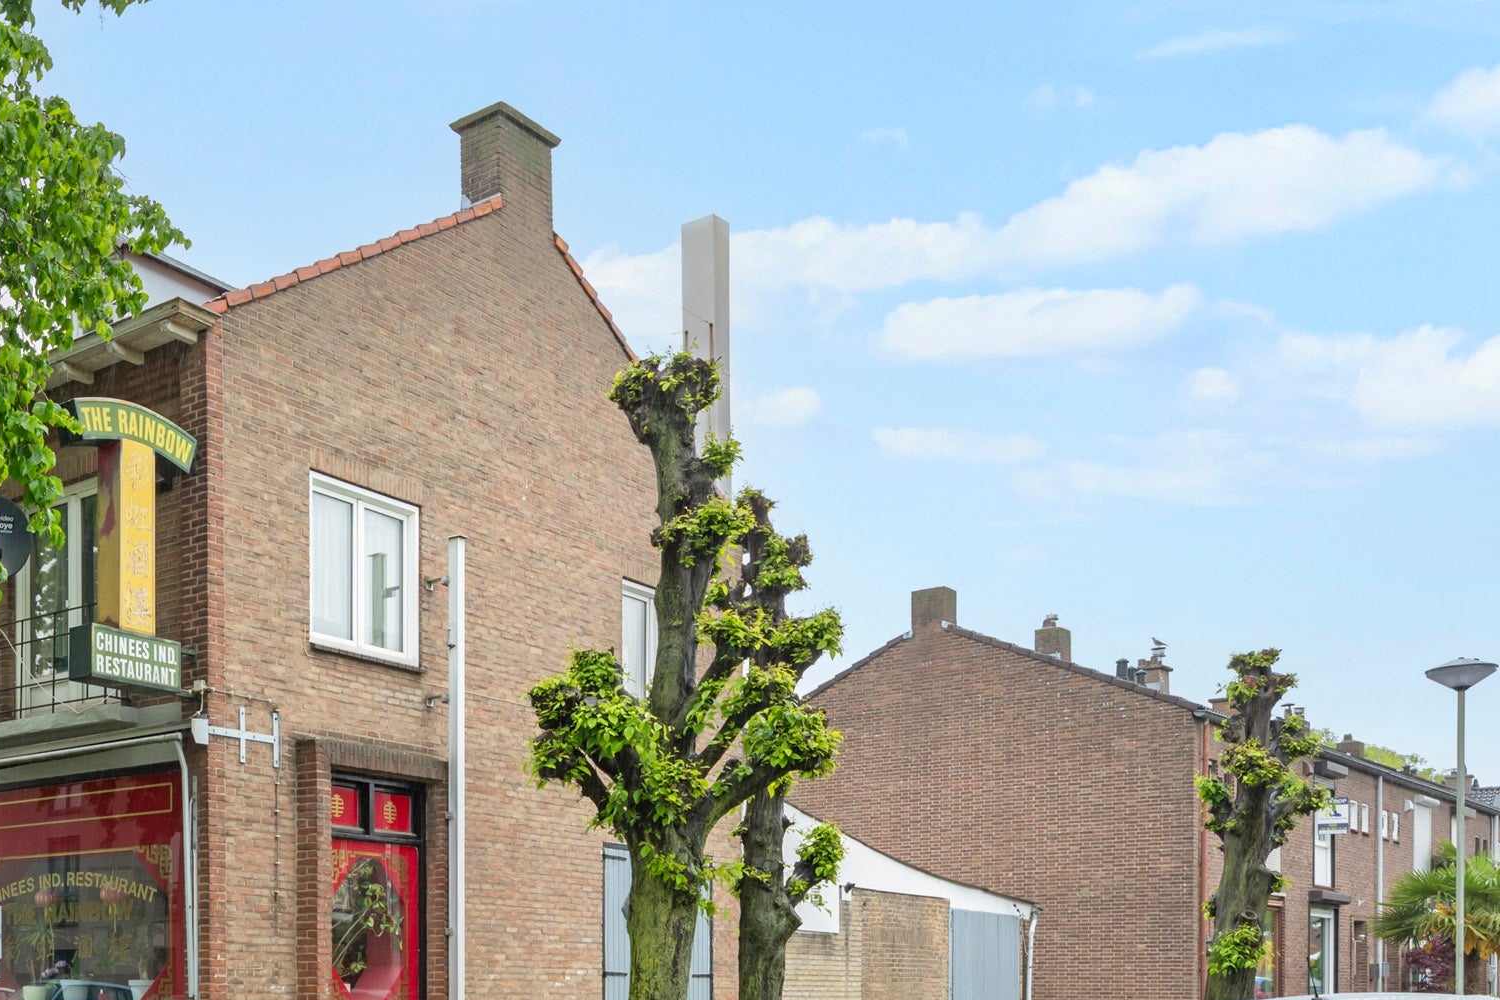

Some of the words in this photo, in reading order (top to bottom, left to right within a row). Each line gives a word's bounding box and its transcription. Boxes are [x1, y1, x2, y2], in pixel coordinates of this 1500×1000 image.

[81, 406, 112, 432] THE
[117, 408, 192, 464] RAINBOW
[96, 632, 150, 660] CHINEES
[154, 643, 178, 665] IND.
[96, 653, 176, 687] RESTAURANT
[39, 873, 65, 889] IND.
[66, 871, 158, 903] RESTAURANT
[4, 904, 36, 925] THE
[44, 900, 134, 924] RAINBOW
